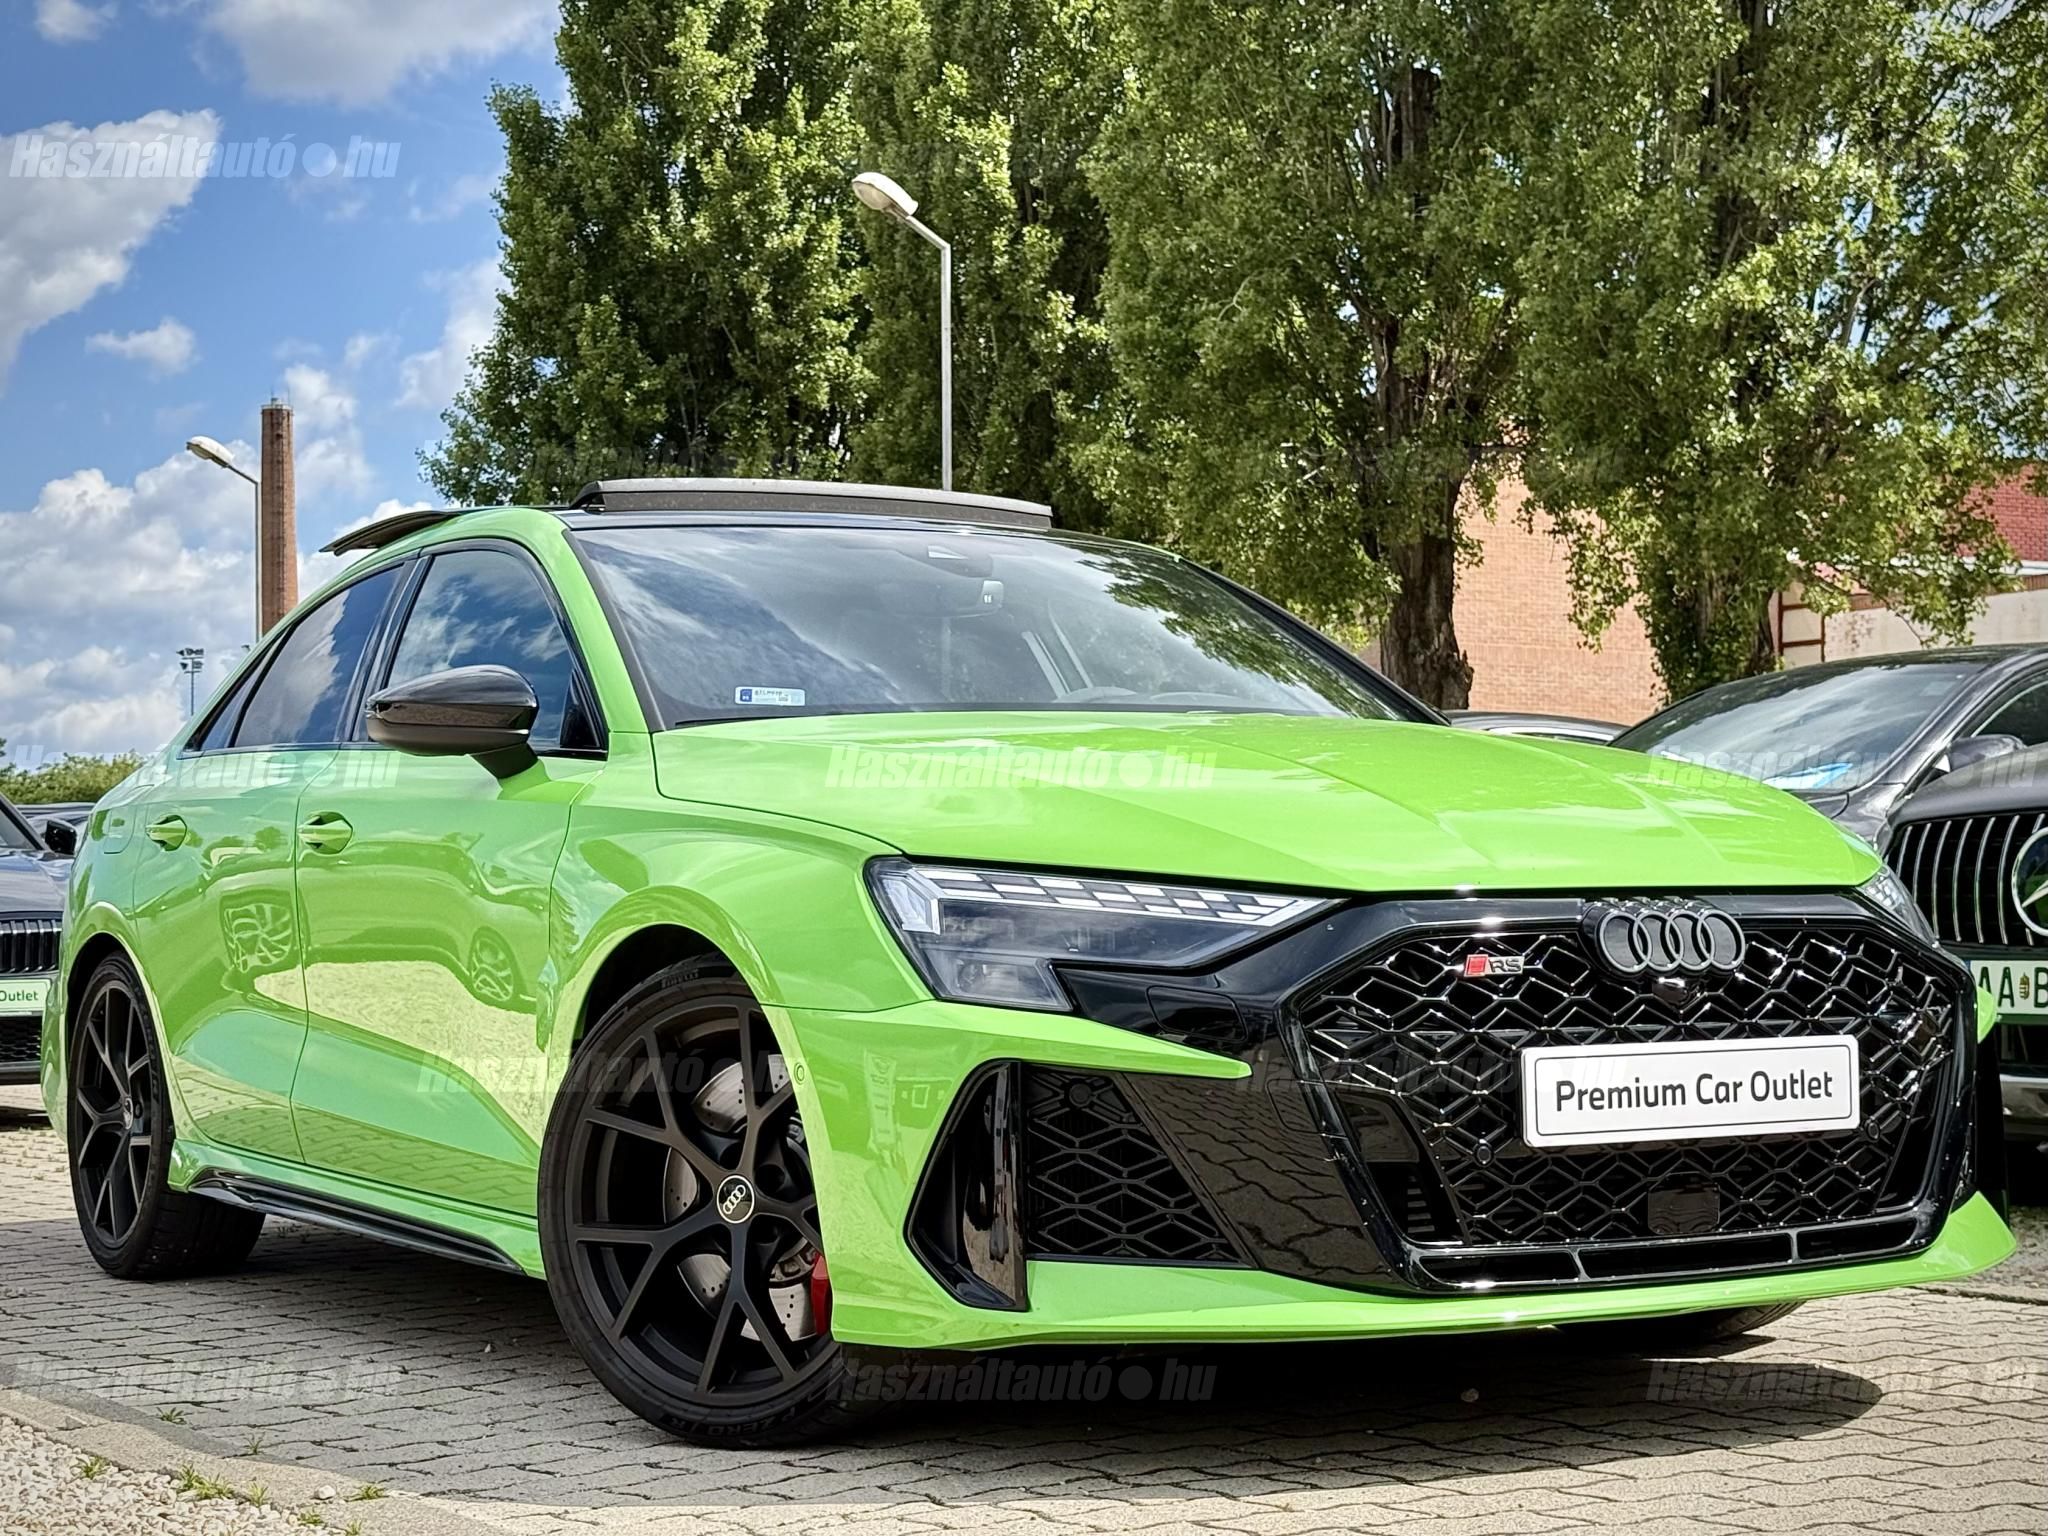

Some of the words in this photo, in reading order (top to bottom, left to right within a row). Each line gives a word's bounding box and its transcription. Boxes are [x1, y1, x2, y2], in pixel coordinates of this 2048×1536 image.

[1489, 958, 1522, 973] RS
[0, 989, 39, 1002] Outlet
[1555, 1077, 1686, 1111] Premium
[1695, 1073, 1743, 1105] Car
[1750, 1069, 1833, 1102] Outlet
